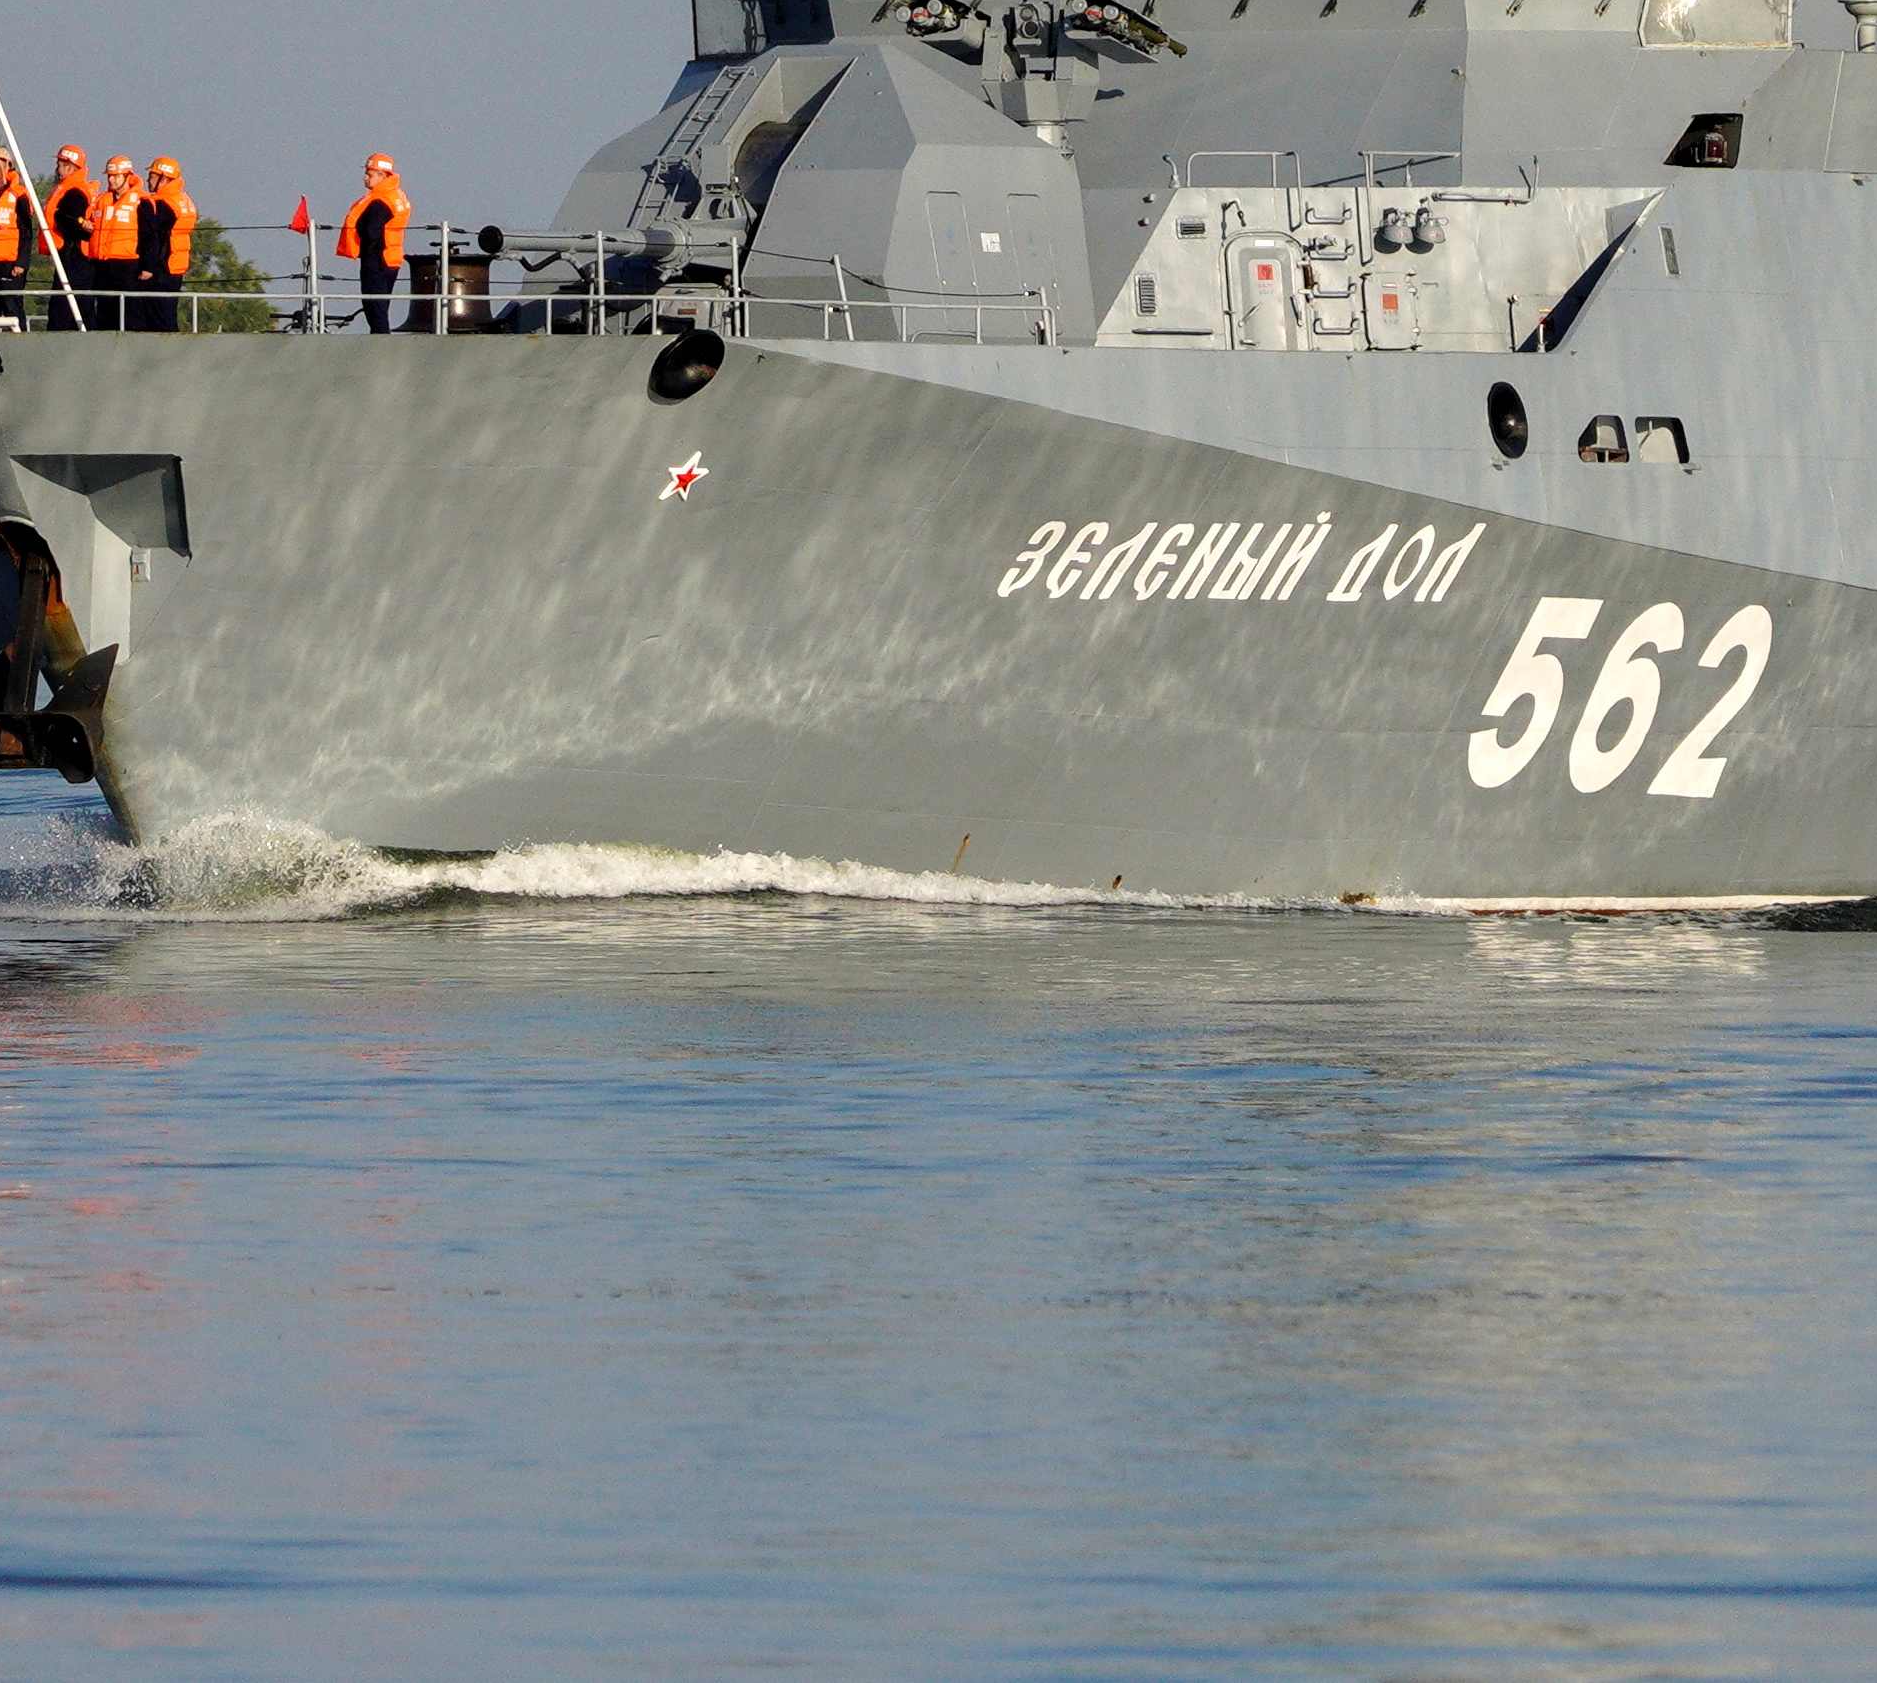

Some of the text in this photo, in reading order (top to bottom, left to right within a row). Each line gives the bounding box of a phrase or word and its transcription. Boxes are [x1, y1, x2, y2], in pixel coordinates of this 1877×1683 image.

[997, 511, 1487, 603] ЗЕЛЕНЫЙ ДОЛ
[1467, 596, 1773, 799] 562
